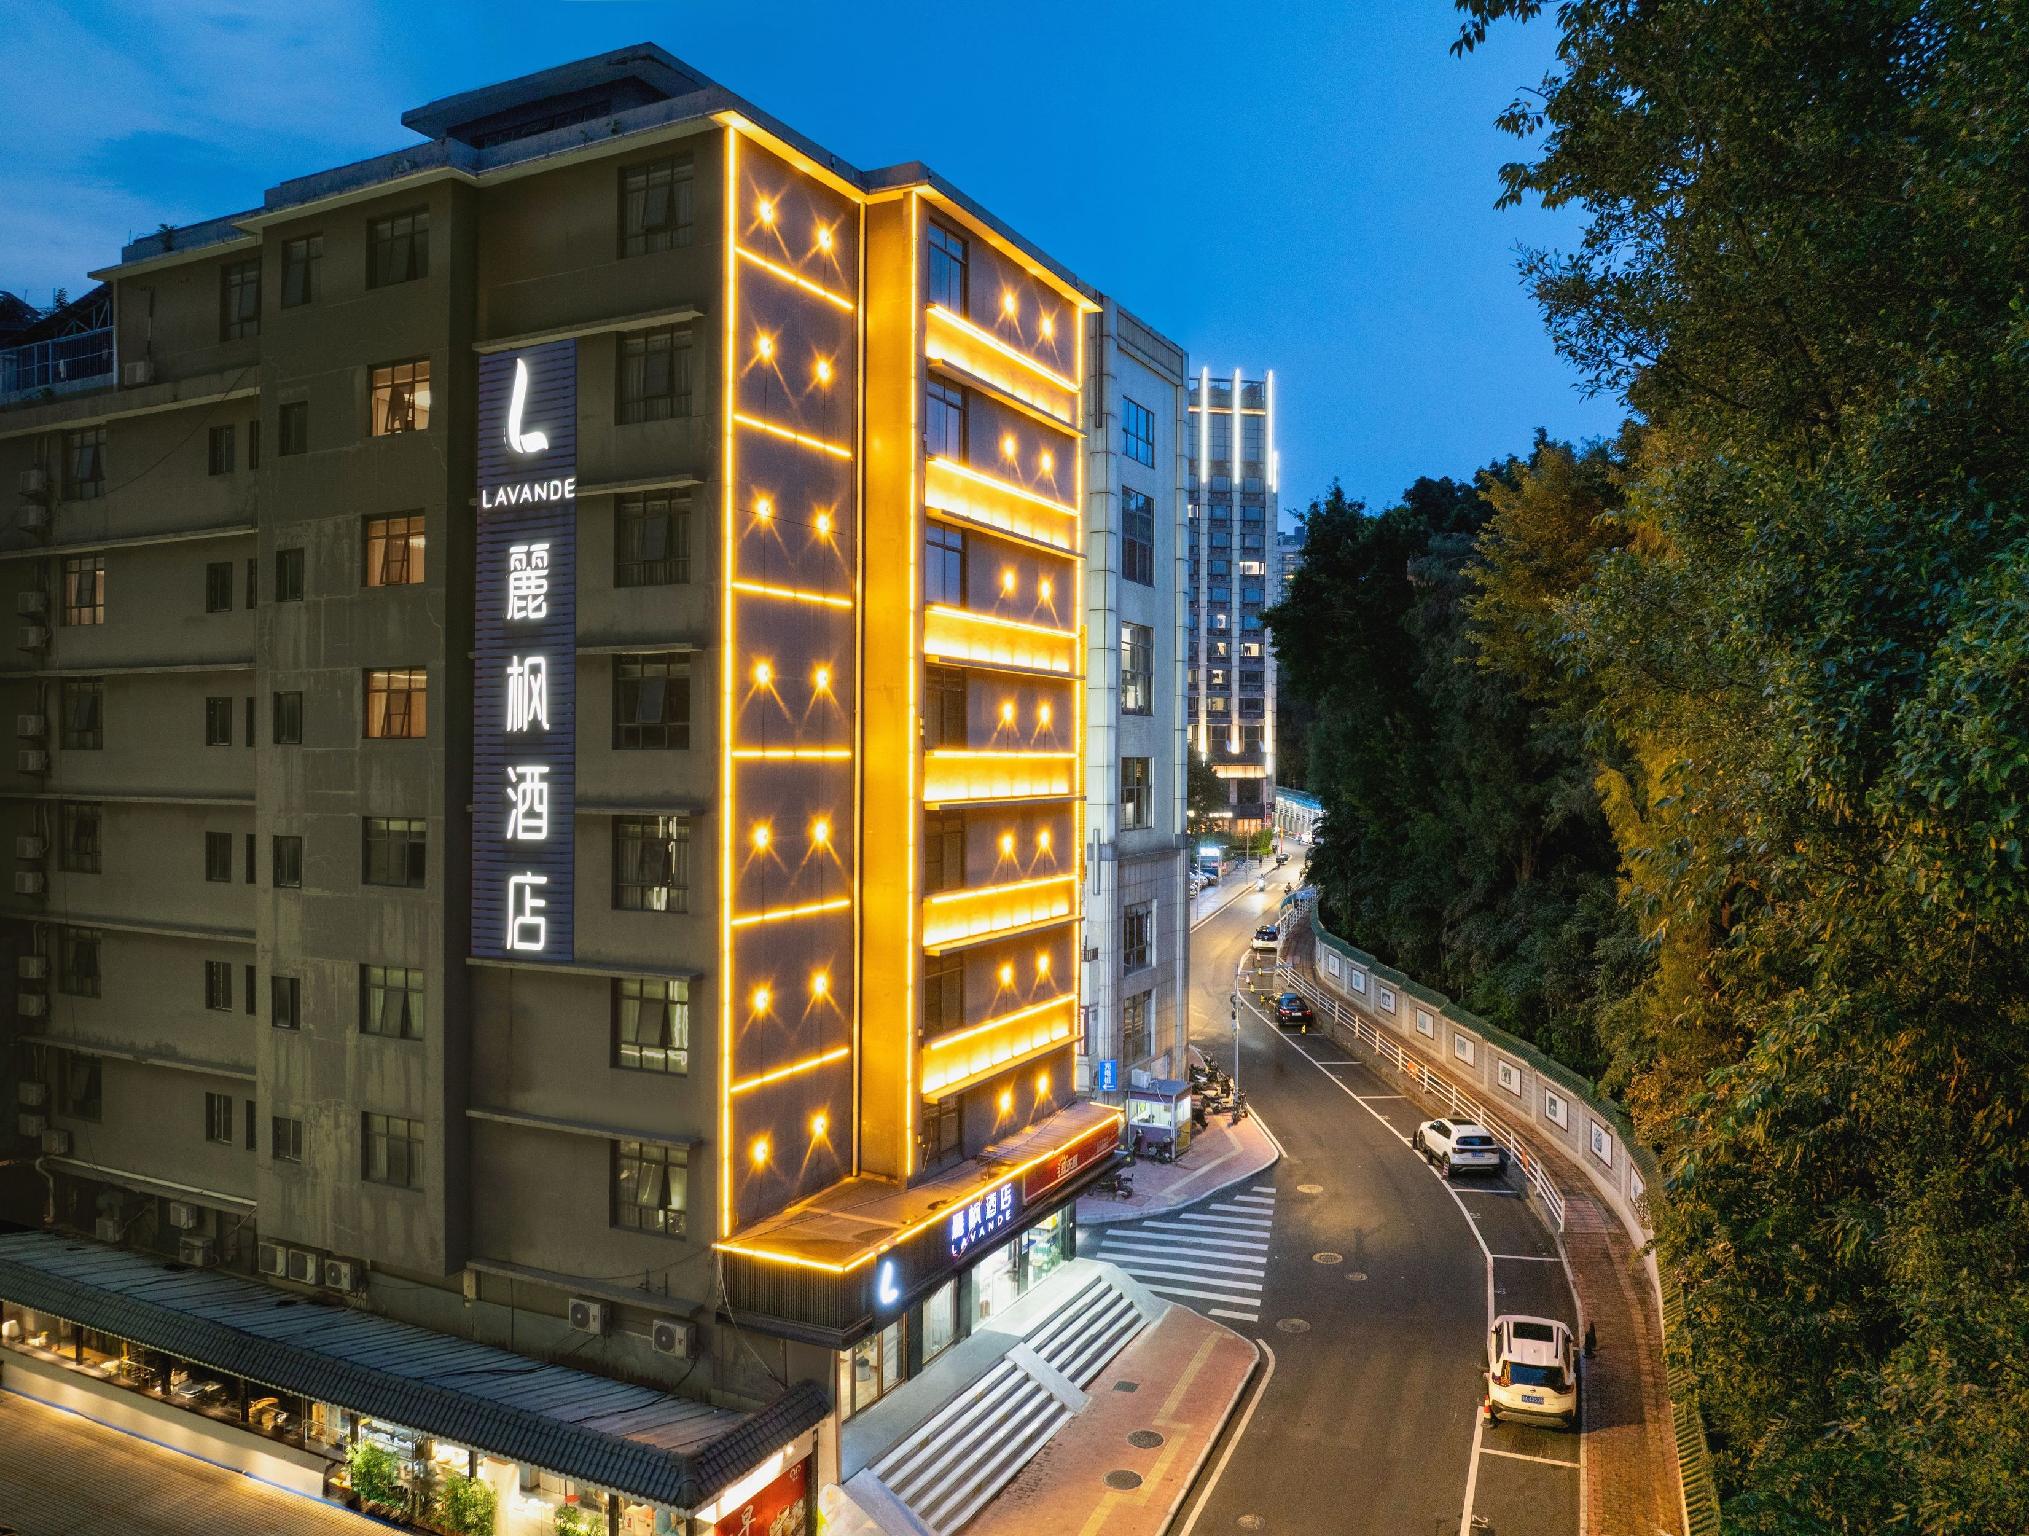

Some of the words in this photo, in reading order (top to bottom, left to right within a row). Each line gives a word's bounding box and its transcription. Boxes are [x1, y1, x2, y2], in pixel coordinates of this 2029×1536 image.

[482, 477, 576, 508] LAVANDE
[506, 543, 549, 951] 麗枫酒店
[951, 1209, 1011, 1257] LAVANDE
